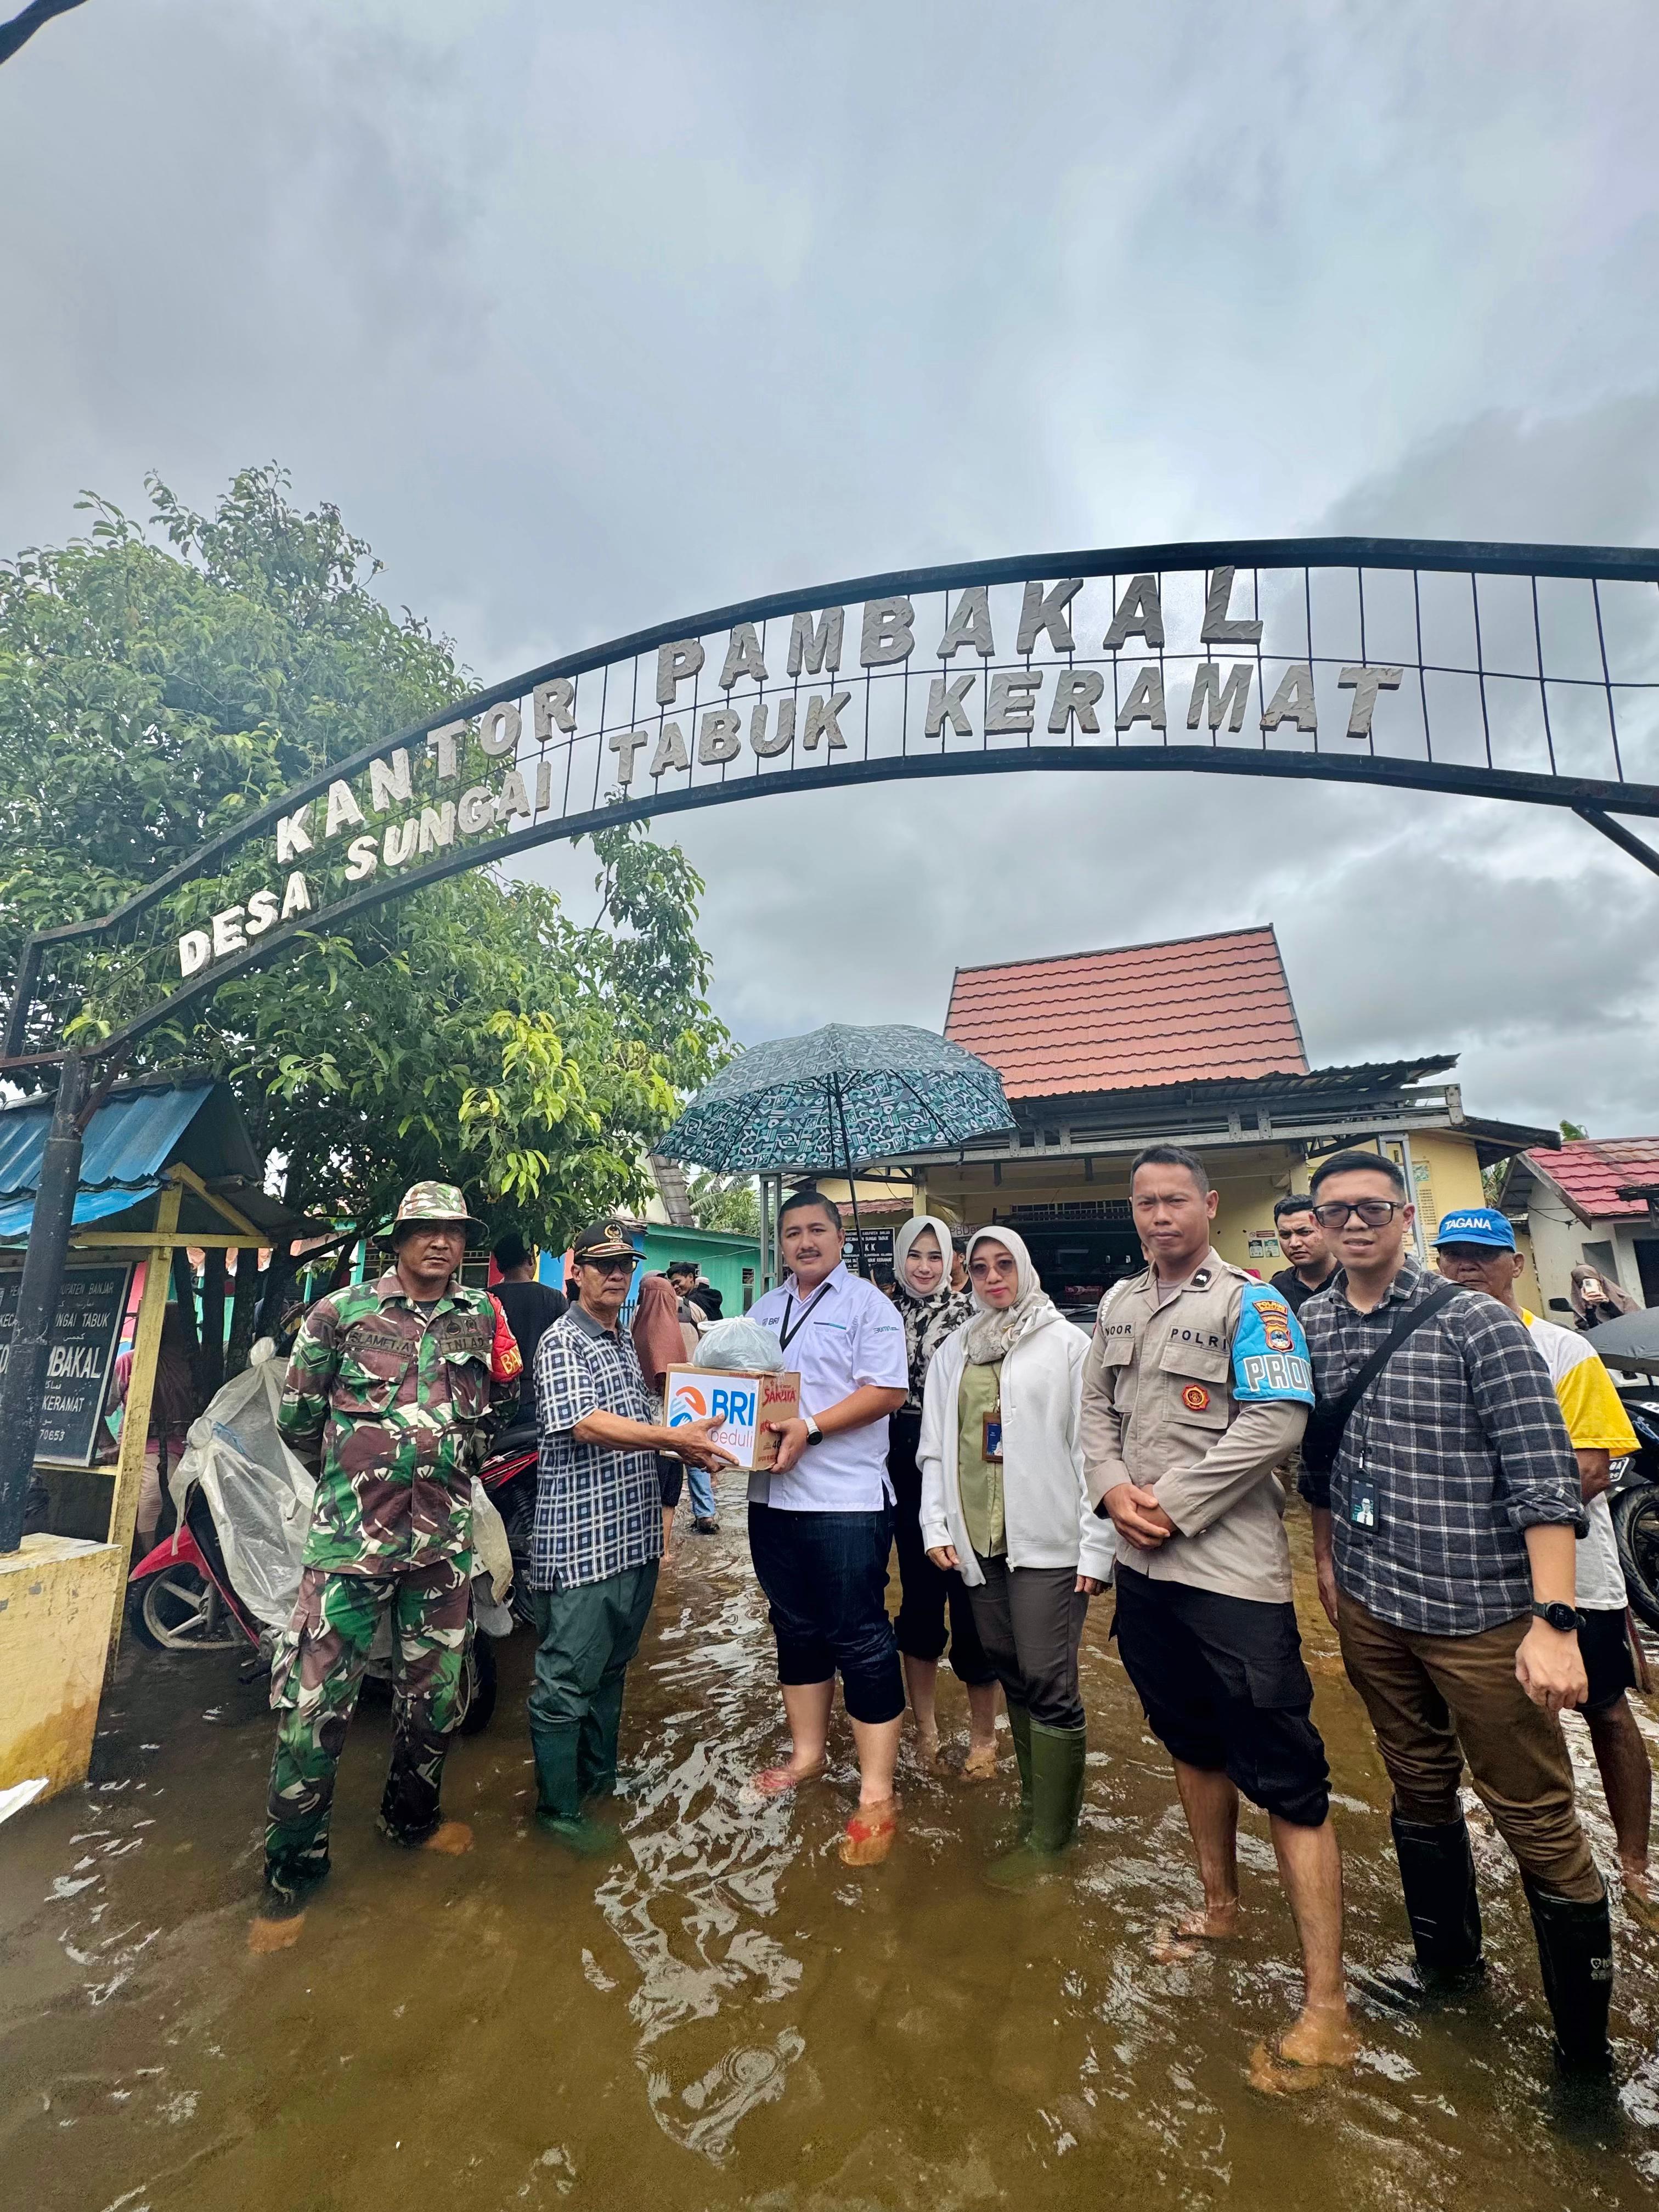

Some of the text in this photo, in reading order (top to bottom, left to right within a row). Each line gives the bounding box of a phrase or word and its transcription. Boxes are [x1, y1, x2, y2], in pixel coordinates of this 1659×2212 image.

[276, 565, 1263, 865] KANTOR PAMBAKAL
[178, 662, 1404, 978] DESA SUNGAI TABUK KERAMAT
[1445, 1218, 1493, 1231] TAGANA
[88, 1282, 114, 1295] BANJAR
[82, 1313, 110, 1327] TABUK
[768, 1317, 780, 1325] BRI
[1105, 1324, 1131, 1336] NOOR
[1171, 1328, 1227, 1350] POLRI
[42, 1395, 84, 1412] KERAMAT
[712, 1389, 755, 1426] BRI
